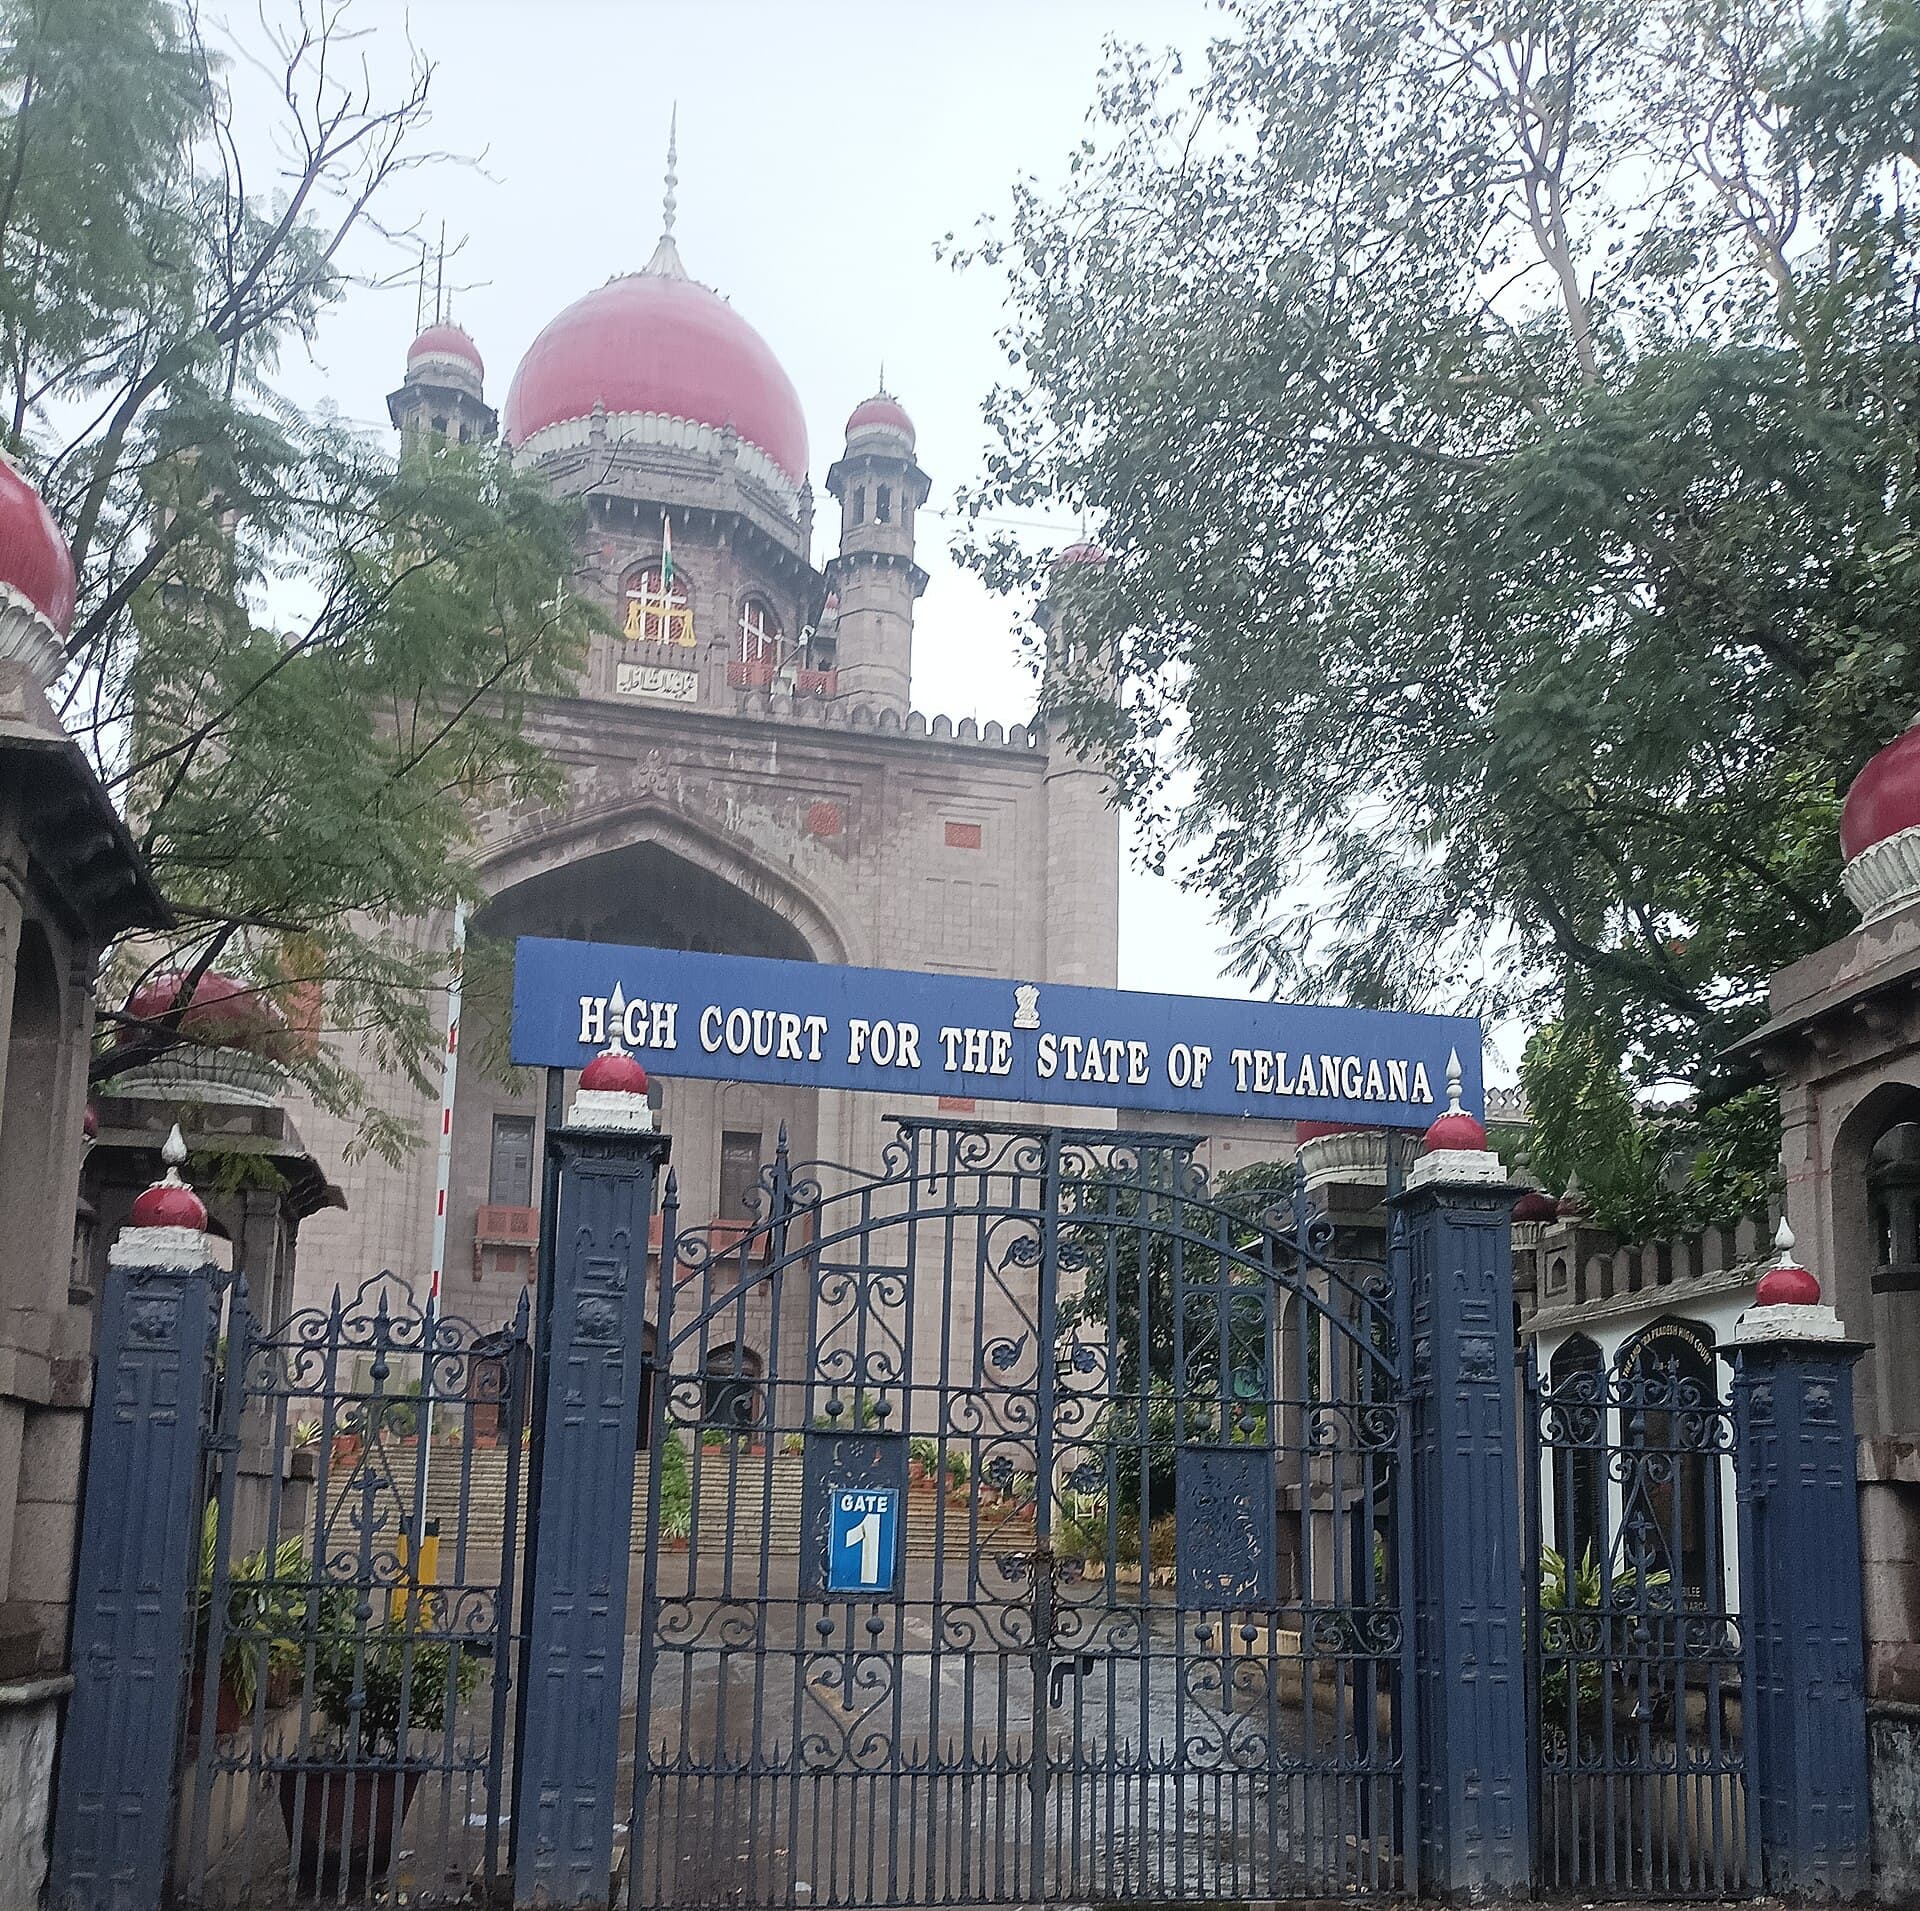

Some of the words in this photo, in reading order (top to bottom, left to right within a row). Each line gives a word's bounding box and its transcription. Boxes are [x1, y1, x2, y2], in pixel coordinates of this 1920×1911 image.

[578, 996, 678, 1050] HGH
[700, 1004, 827, 1061] COURT
[847, 1018, 921, 1068] FOR
[939, 1026, 1012, 1077] THE
[1036, 1032, 1149, 1085] STATE
[1168, 1042, 1212, 1089] OF
[1230, 1048, 1434, 1104] TELANGANA
[1622, 1359, 1633, 1378] THE
[1630, 1333, 1652, 1362] ANDRA
[1651, 1325, 1678, 1340] PRADESH
[1678, 1328, 1695, 1345] HIGH
[1694, 1338, 1712, 1366] COURT
[841, 1494, 888, 1513] GATE
[845, 1513, 881, 1585] 1
